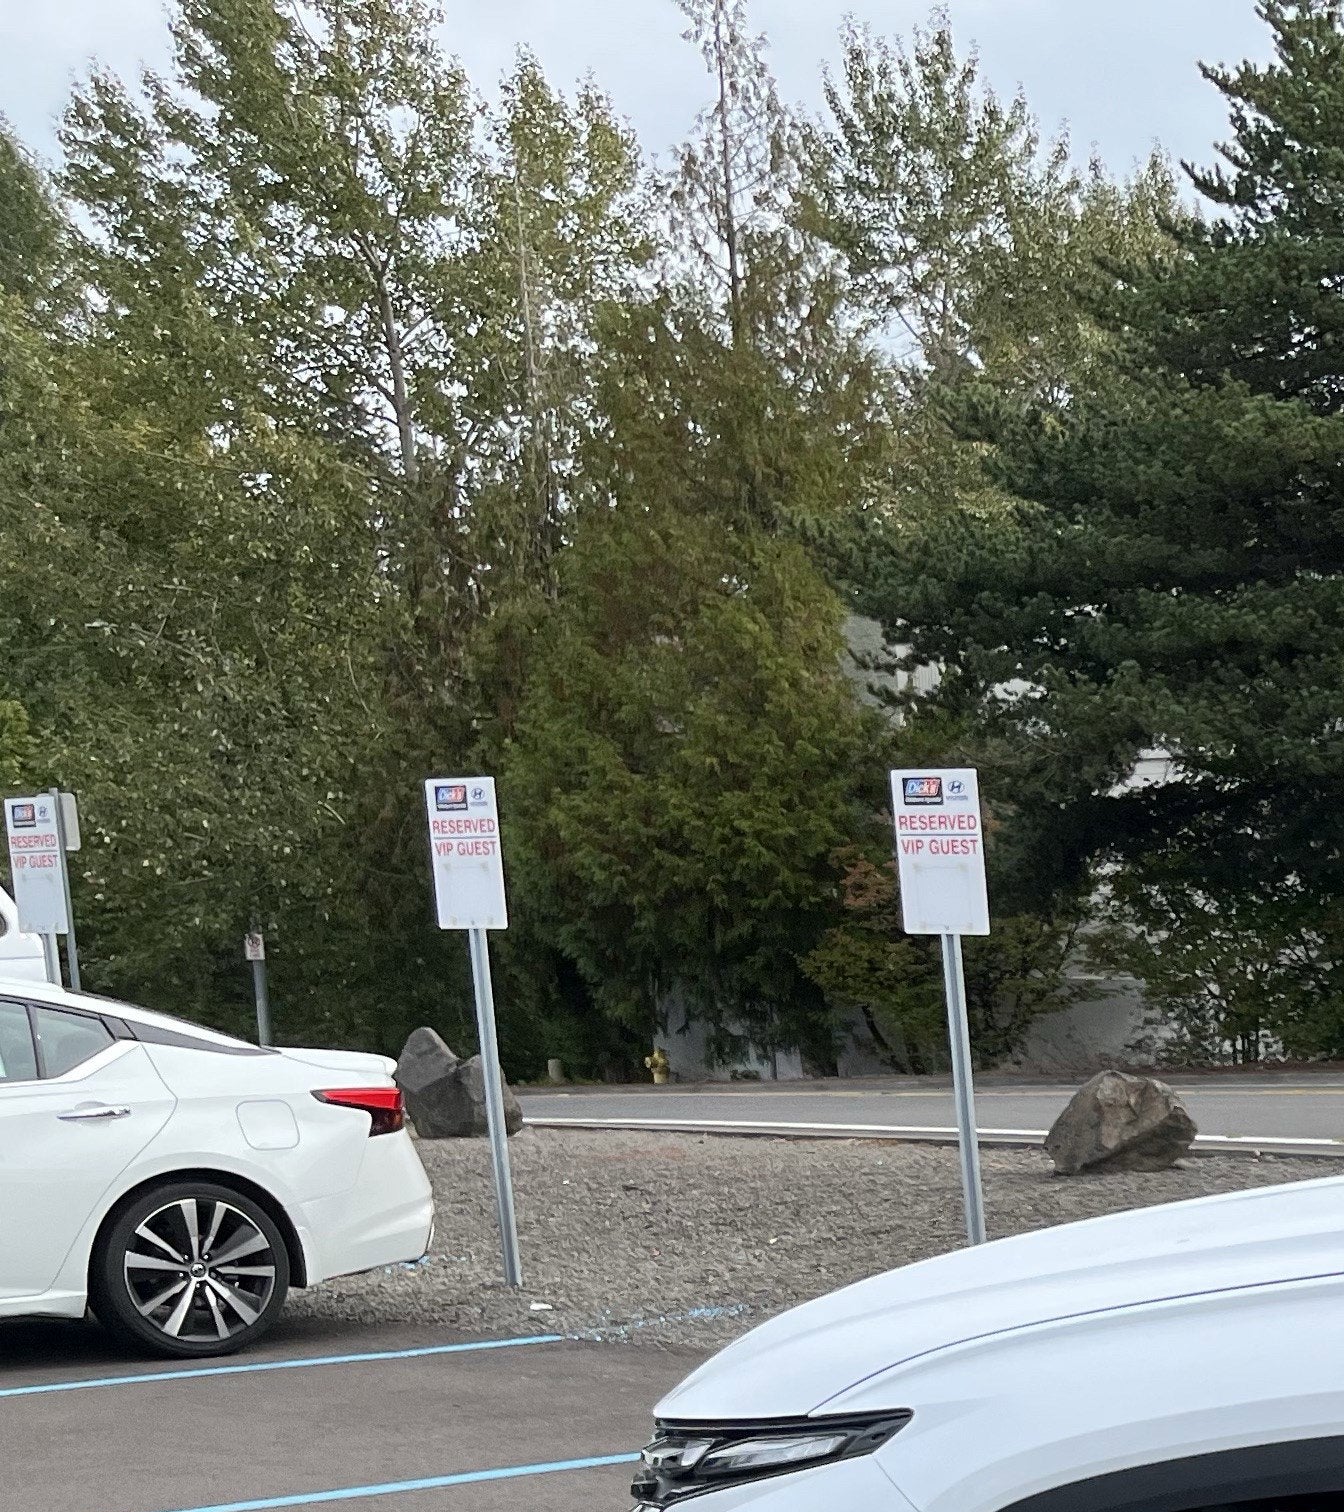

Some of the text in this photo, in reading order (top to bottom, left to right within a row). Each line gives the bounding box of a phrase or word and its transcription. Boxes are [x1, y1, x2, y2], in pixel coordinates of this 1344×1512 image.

[432, 818, 496, 835] RESERVED
[898, 814, 977, 831] RESERVED
[10, 834, 57, 849] RESERVED
[434, 841, 497, 857] VIP GUEST
[901, 839, 979, 855] VIP GUEST
